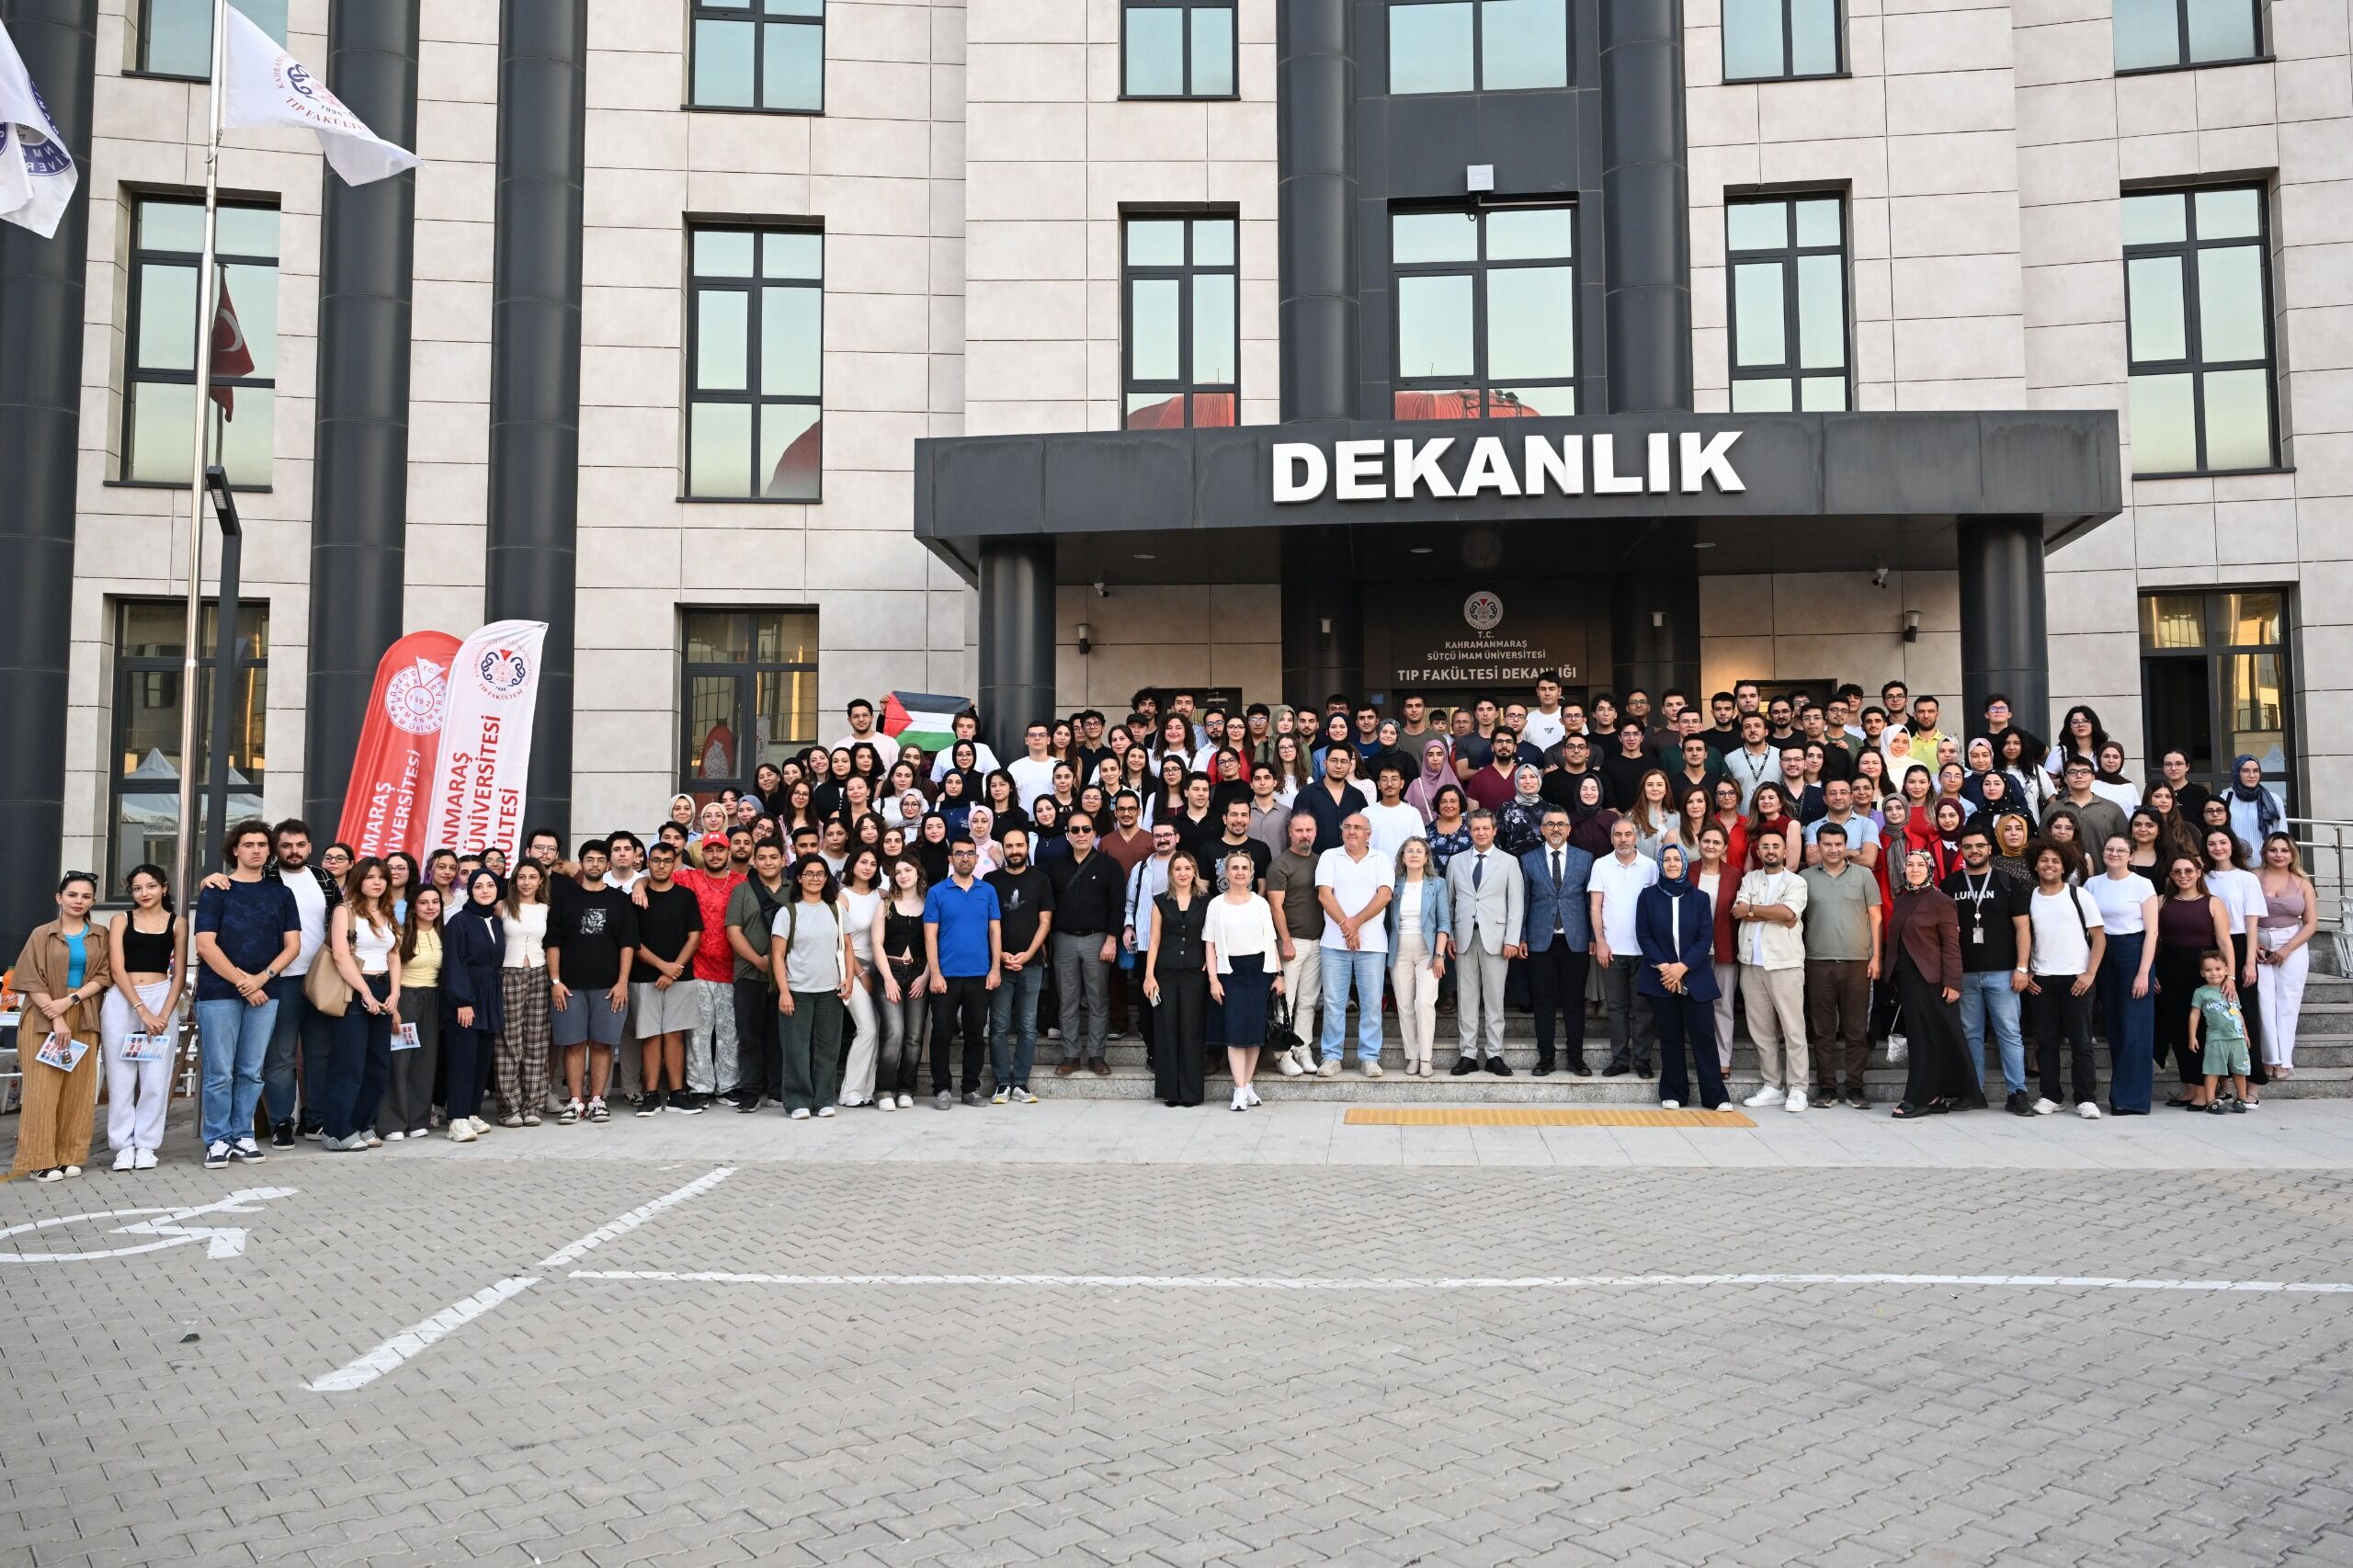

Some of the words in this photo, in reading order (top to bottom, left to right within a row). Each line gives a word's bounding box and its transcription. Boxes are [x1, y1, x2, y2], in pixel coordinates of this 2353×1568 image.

[1273, 431, 1746, 504] DEKANLIK
[1445, 641, 1528, 649] KAHRAMANMARAŞ
[1427, 651, 1456, 661] SÜTÇÜ
[1458, 651, 1483, 660] İMAM
[1484, 649, 1546, 659] ÜNİVERSİTESİ
[1397, 670, 1419, 681] TIP
[1423, 665, 1498, 680] FAKÜLTESİ
[463, 715, 501, 853] ÜNİVERSİTESİ
